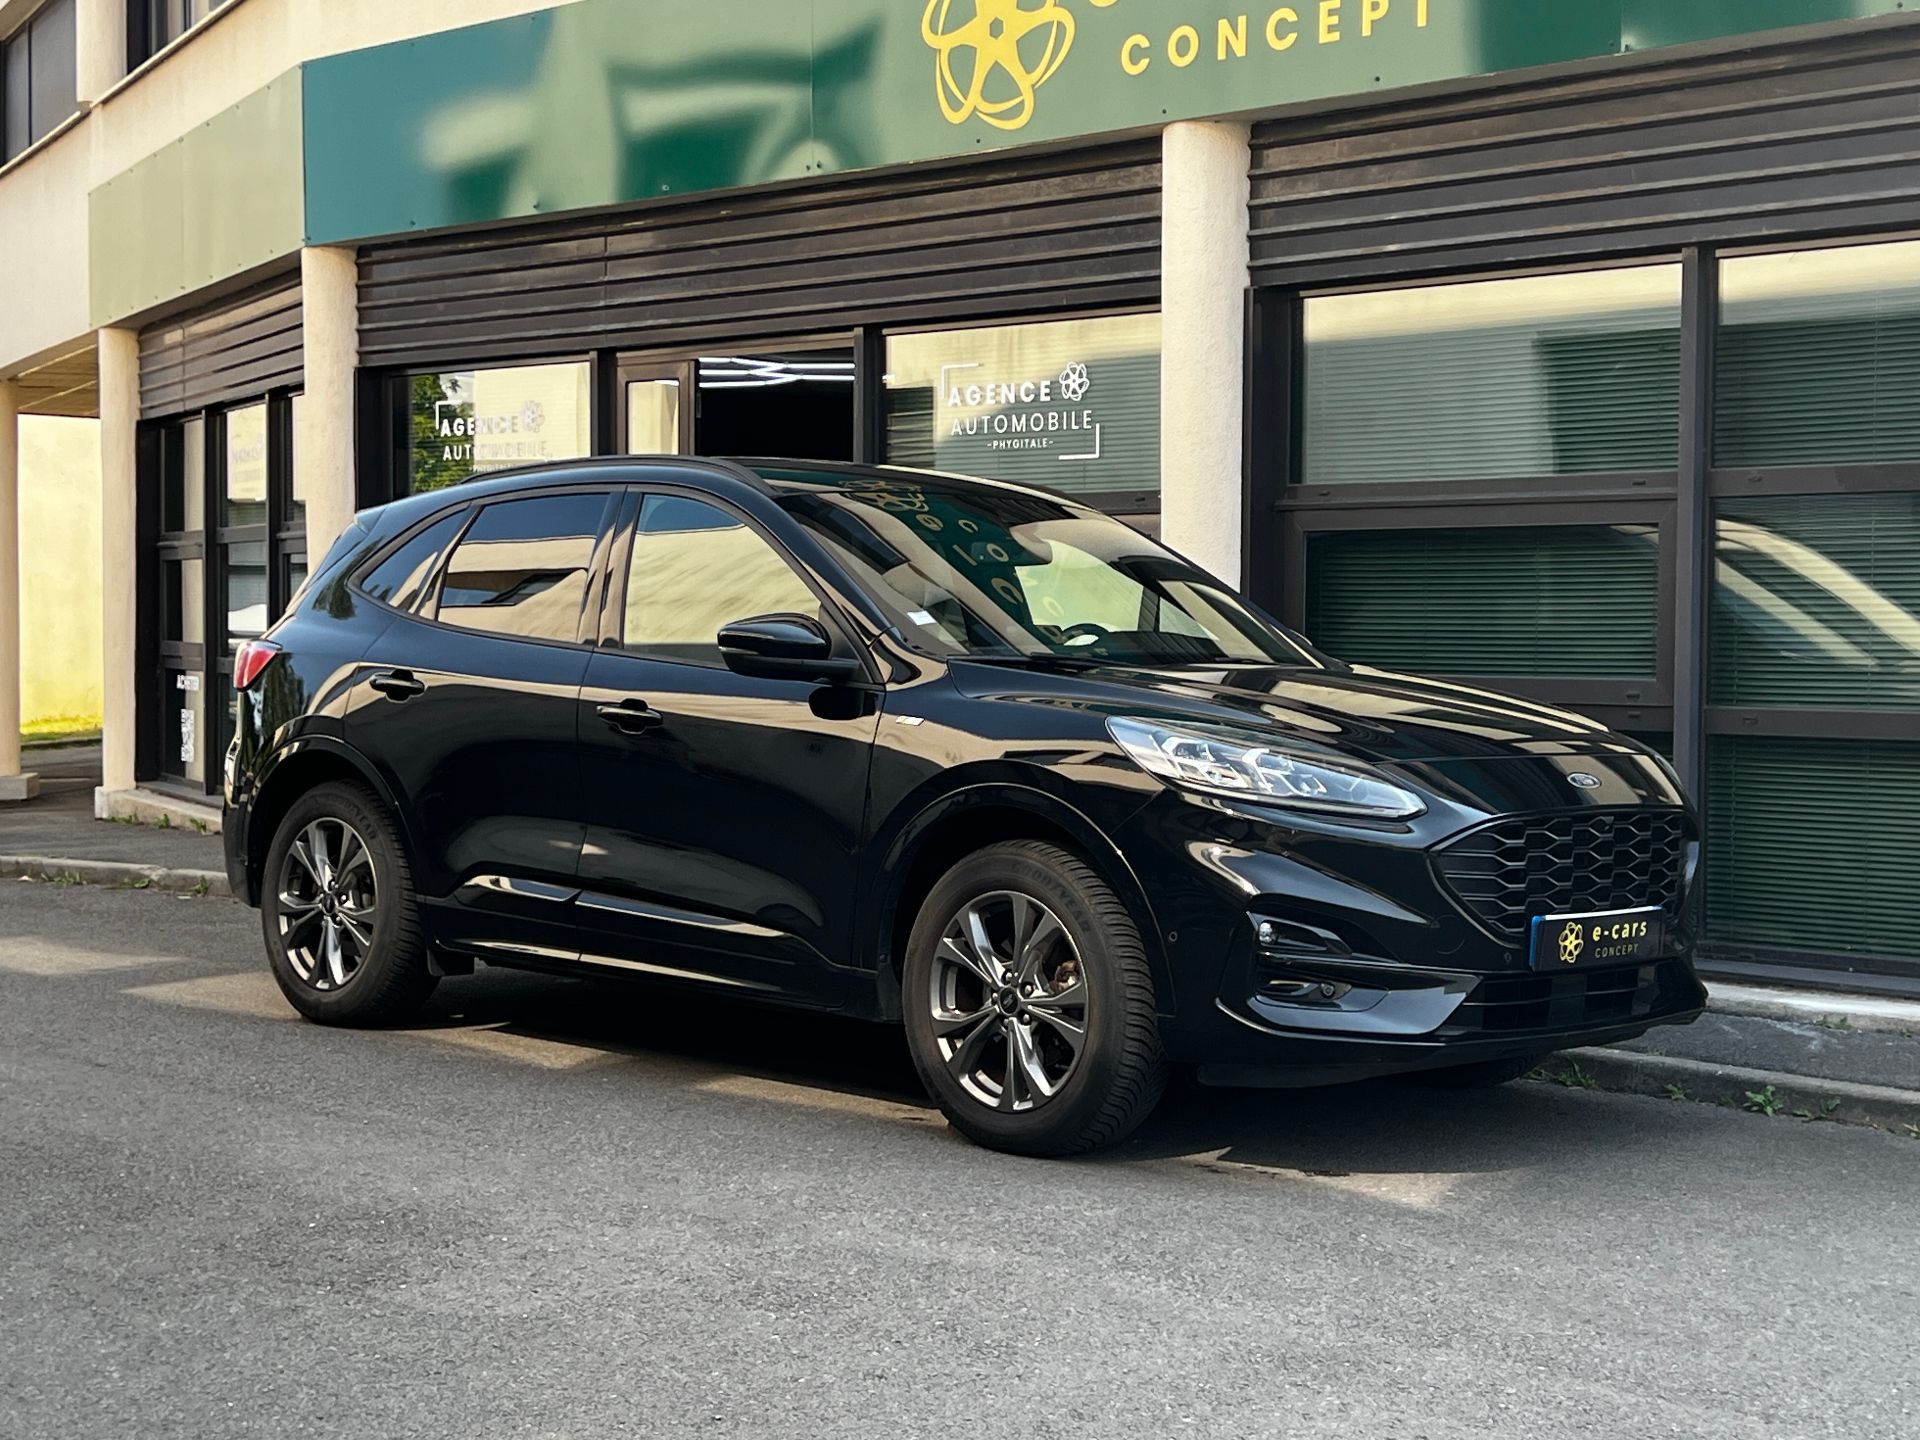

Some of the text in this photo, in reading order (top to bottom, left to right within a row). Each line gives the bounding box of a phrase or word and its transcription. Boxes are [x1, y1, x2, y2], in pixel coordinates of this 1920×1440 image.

[949, 380, 1051, 408] AGENCE
[440, 416, 519, 438] AGENCE
[951, 409, 1093, 436] AUTOMOBILE
[1592, 920, 1648, 942] e-cars
[1594, 943, 1640, 959] CONCEPT
